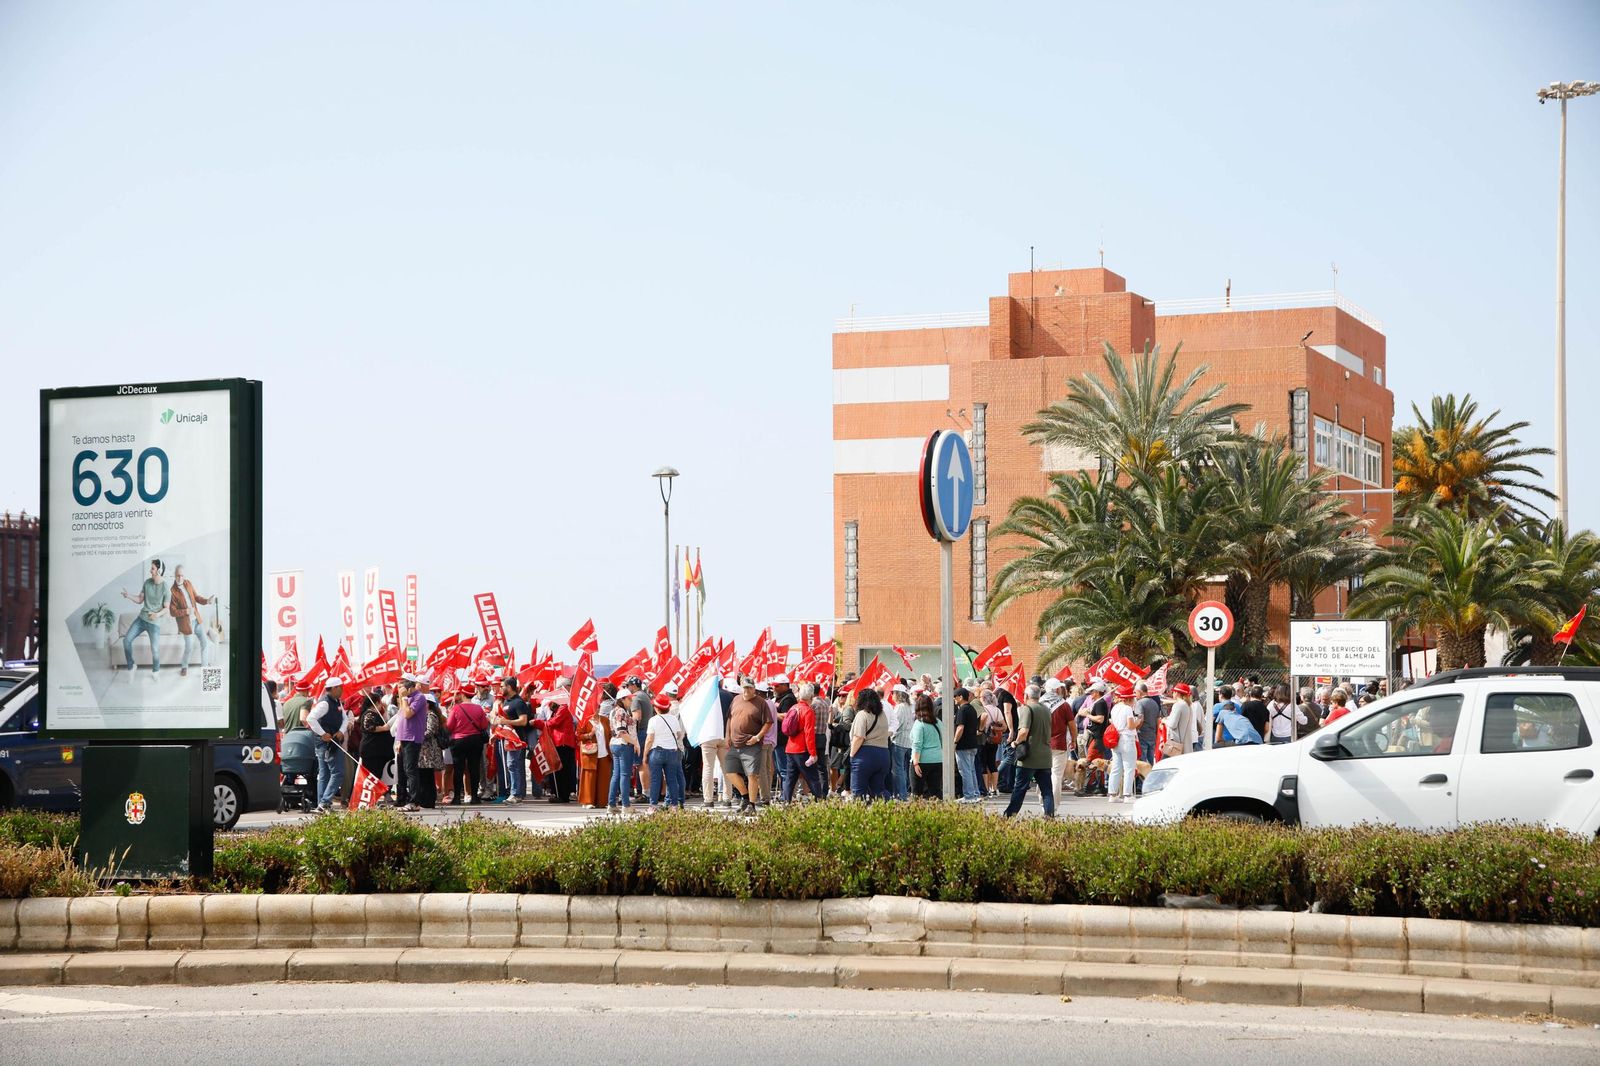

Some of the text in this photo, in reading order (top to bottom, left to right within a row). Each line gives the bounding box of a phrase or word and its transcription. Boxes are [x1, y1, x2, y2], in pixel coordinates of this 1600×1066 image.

[117, 386, 158, 395] JCDecaux
[176, 412, 208, 424] Unicaja
[72, 433, 136, 445] Te damos hasta
[72, 446, 169, 506] 630
[72, 508, 153, 521] razones para venirte
[72, 521, 124, 531] con nosotros
[276, 575, 298, 651] UGT
[341, 575, 354, 657] UGT
[366, 572, 376, 656] UGT
[1199, 616, 1224, 632] 30
[575, 675, 597, 721] CCOO
[241, 745, 274, 764] 200
